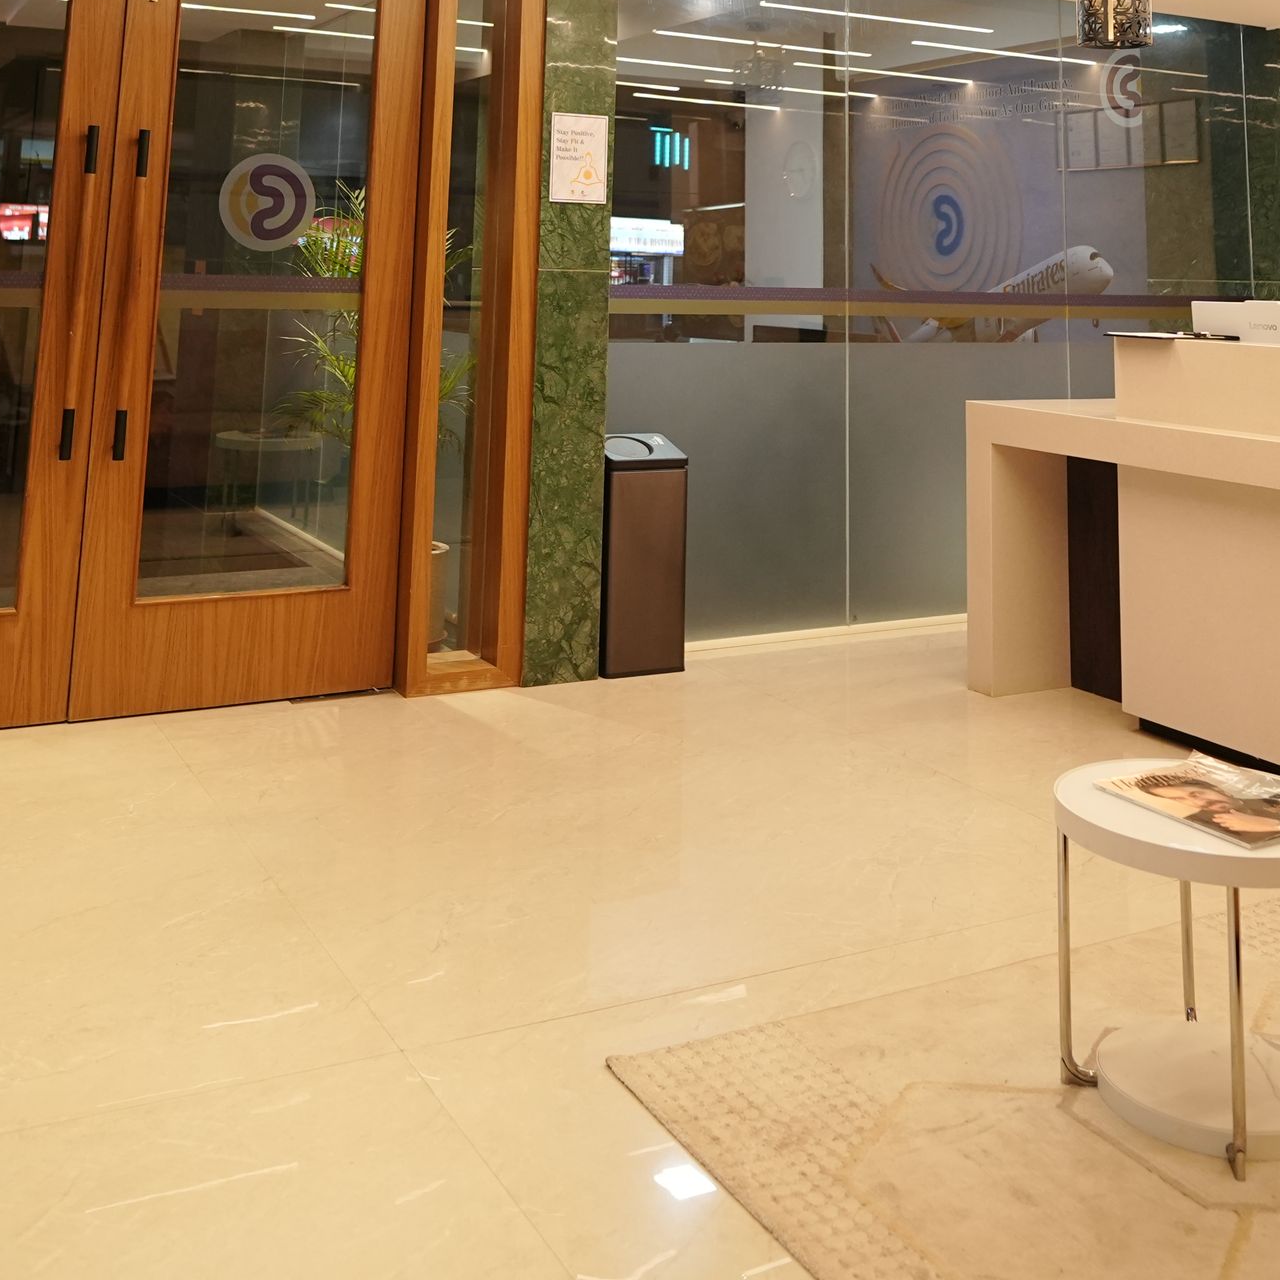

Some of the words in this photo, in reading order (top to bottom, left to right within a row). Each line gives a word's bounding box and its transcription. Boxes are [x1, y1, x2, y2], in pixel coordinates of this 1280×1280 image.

[1007, 80, 1027, 96] And
[978, 104, 997, 117] You
[1016, 98, 1035, 113] Our
[1249, 322, 1277, 331] Lenovo
